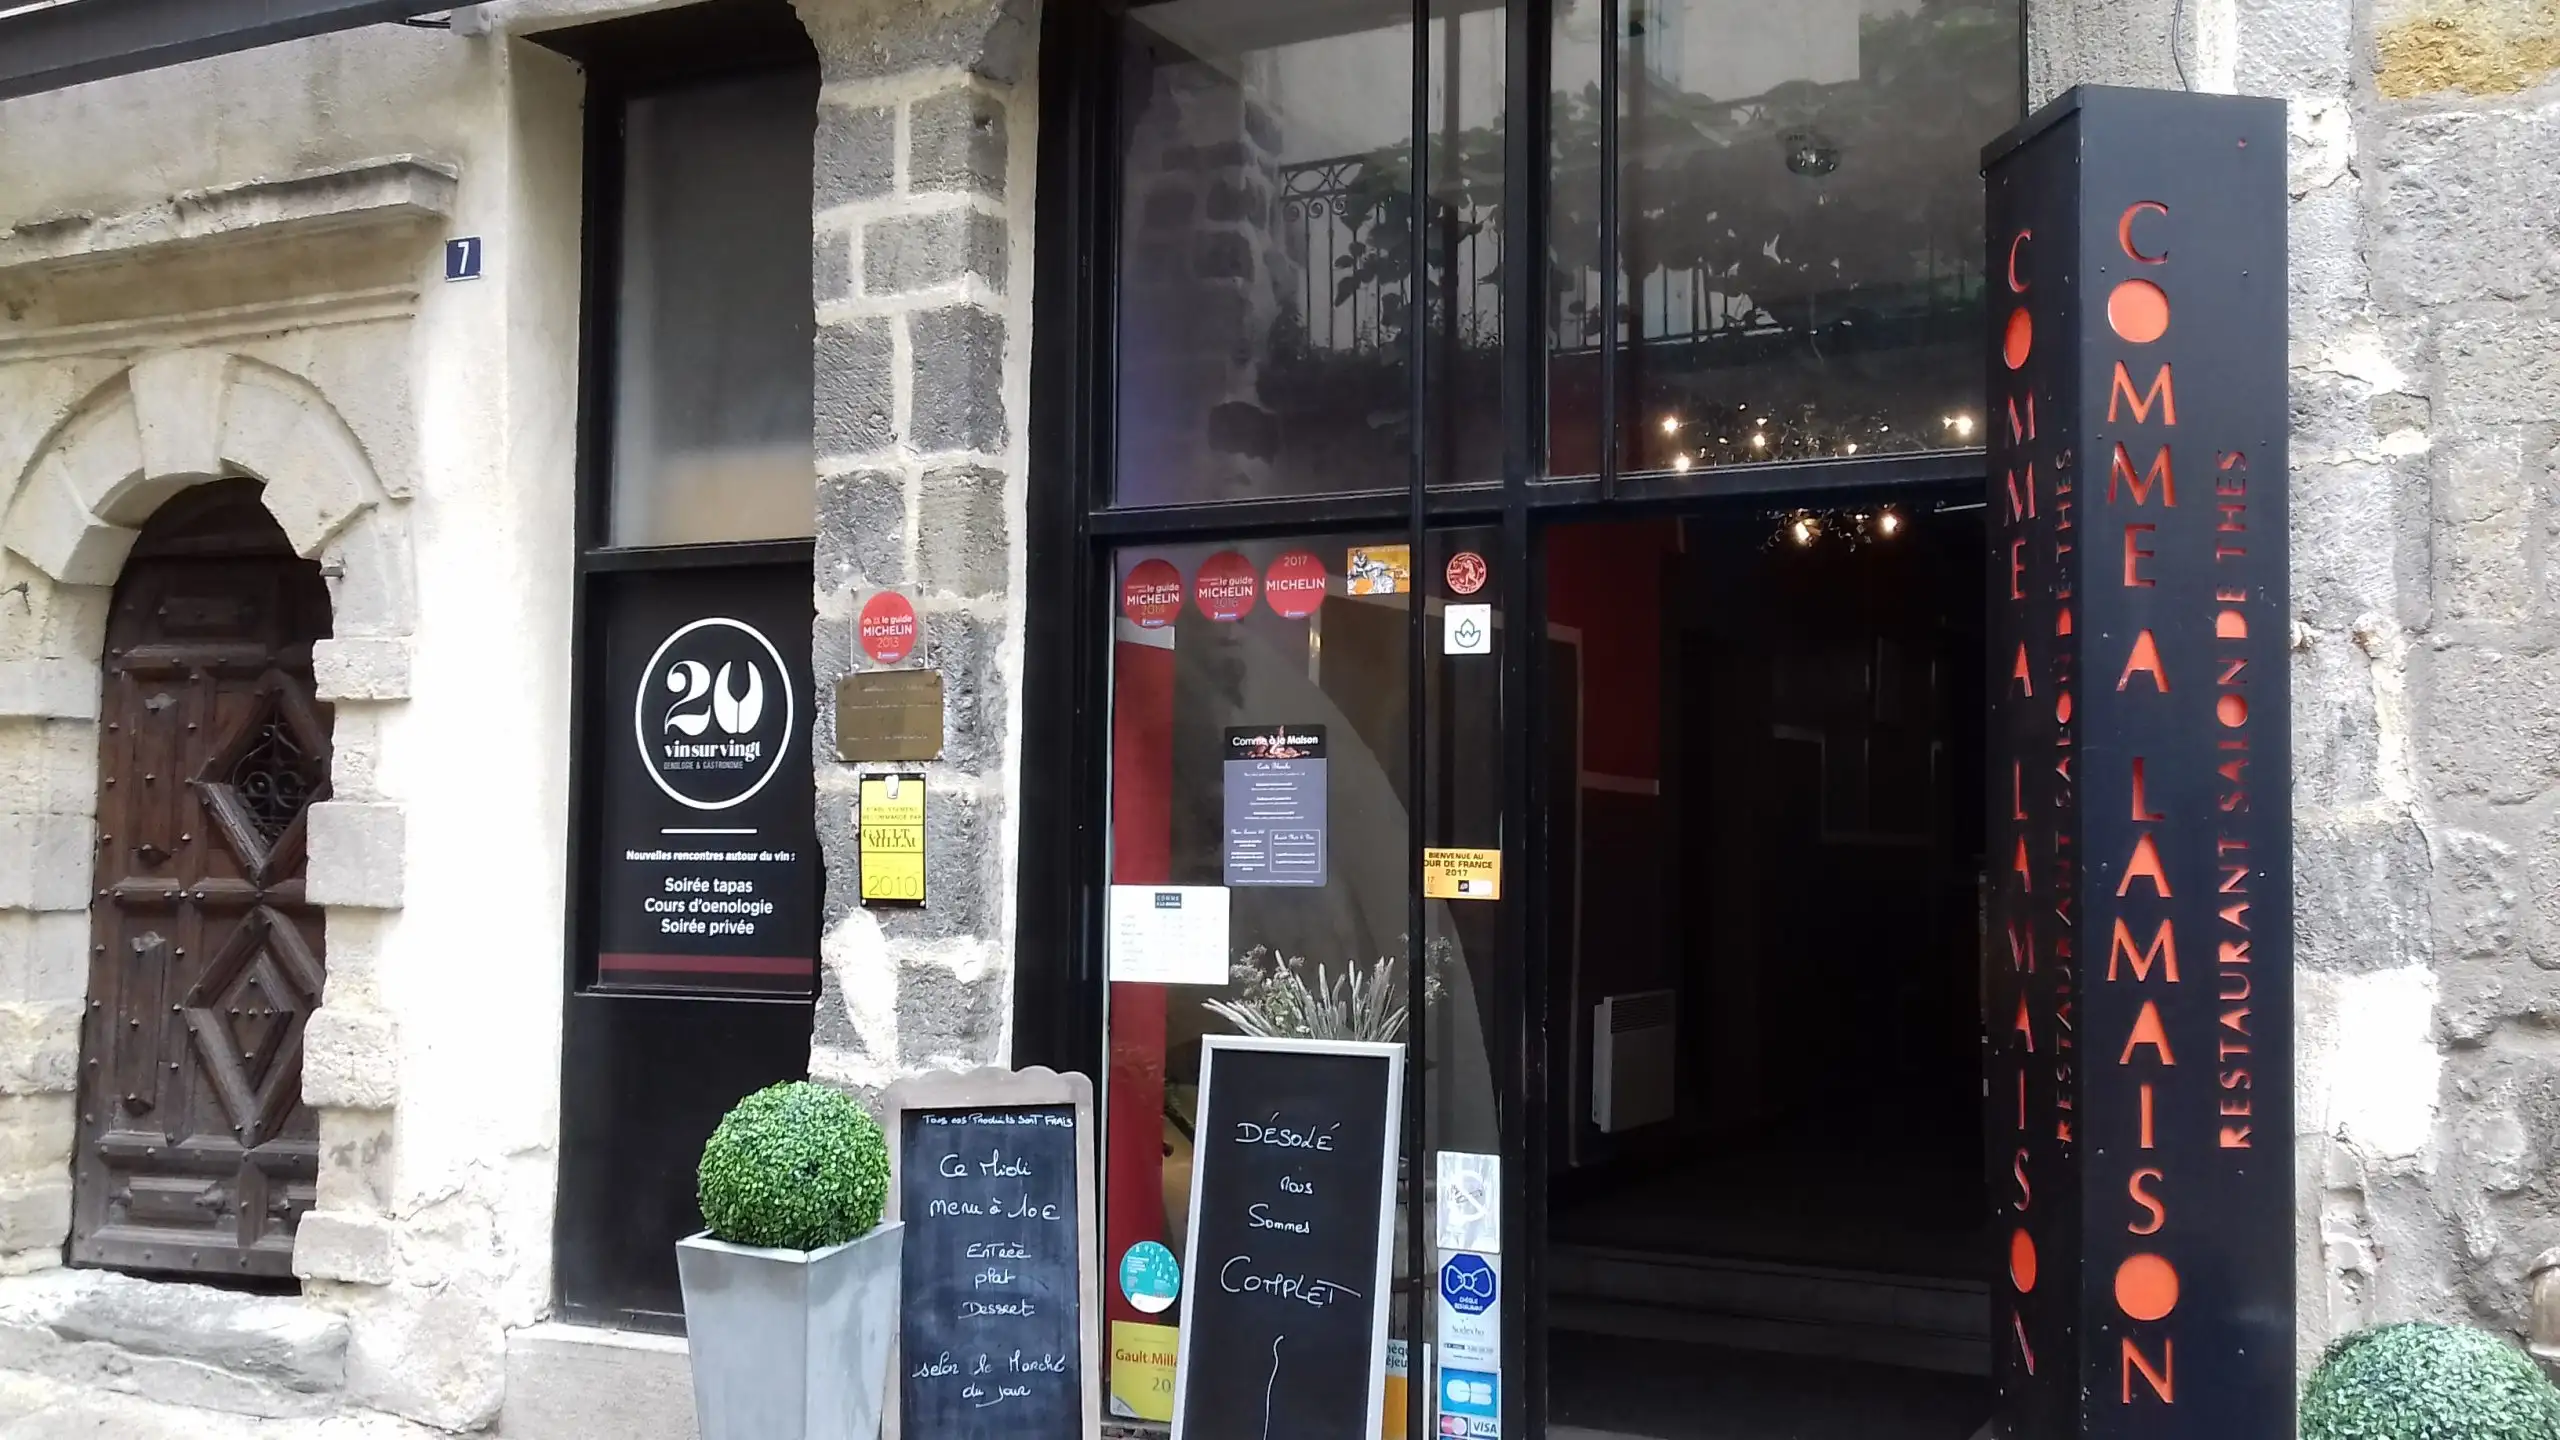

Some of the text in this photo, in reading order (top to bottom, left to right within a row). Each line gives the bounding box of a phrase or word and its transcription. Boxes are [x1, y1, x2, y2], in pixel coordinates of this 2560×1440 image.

[457, 241, 470, 274] 7
[2106, 199, 2179, 587] COMME
[2216, 449, 2248, 563] THES
[1284, 555, 1308, 567] 2017
[1229, 575, 1254, 586] guide
[1266, 577, 1326, 591] MICHELIN
[1156, 583, 1180, 593] guide
[1199, 586, 1253, 599] MICHELIN
[1126, 593, 1180, 606] MICHELIN
[2216, 582, 2249, 639] DE
[890, 614, 912, 625] guide
[863, 624, 913, 637] MICHELIN
[877, 636, 900, 649] 2013
[664, 660, 763, 736] 20
[1232, 737, 1267, 746] Comme
[1287, 735, 1318, 745] Maison
[626, 850, 672, 861] Nouvelles
[673, 852, 724, 861] rencontres
[725, 852, 758, 862] autour
[759, 851, 772, 862] du
[774, 852, 790, 862] vin
[1428, 852, 1471, 860] BIENVENUE
[1443, 860, 1456, 868] DE
[1457, 861, 1493, 869] FRANCE
[1445, 868, 1468, 876] 2017
[664, 877, 753, 895] Soirée tapas
[868, 875, 918, 897] 2010
[644, 898, 685, 913] Cours
[661, 918, 755, 936] Soirée privée
[2216, 833, 2252, 1148] RESTAURANT
[939, 1149, 1031, 1178] Ce Midi
[989, 1197, 1003, 1215] à
[957, 1299, 1036, 1320] Dessert
[1115, 1348, 1148, 1364] Gault
[962, 1382, 985, 1399] du
[1473, 1421, 1498, 1434] VISA
